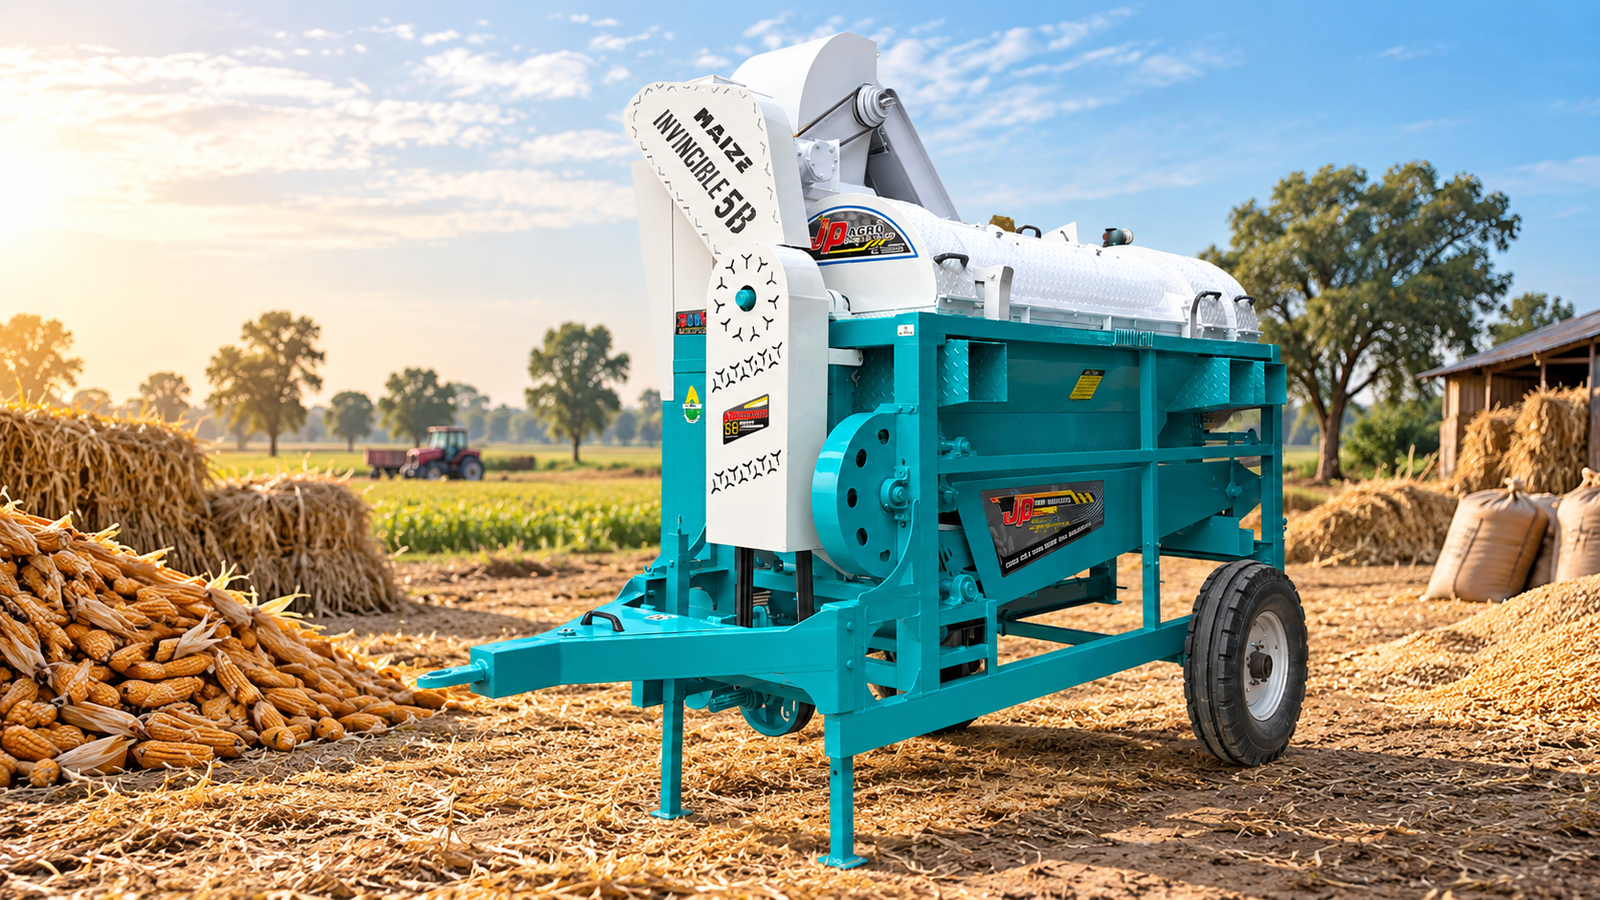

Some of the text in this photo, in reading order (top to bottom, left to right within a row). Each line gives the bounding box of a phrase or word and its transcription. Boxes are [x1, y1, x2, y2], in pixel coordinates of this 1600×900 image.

[693, 107, 754, 174] MAIZE
[652, 109, 757, 234] INVINCIBLE 5B
[848, 224, 885, 237] AGRO
[1003, 497, 1034, 527] JP
